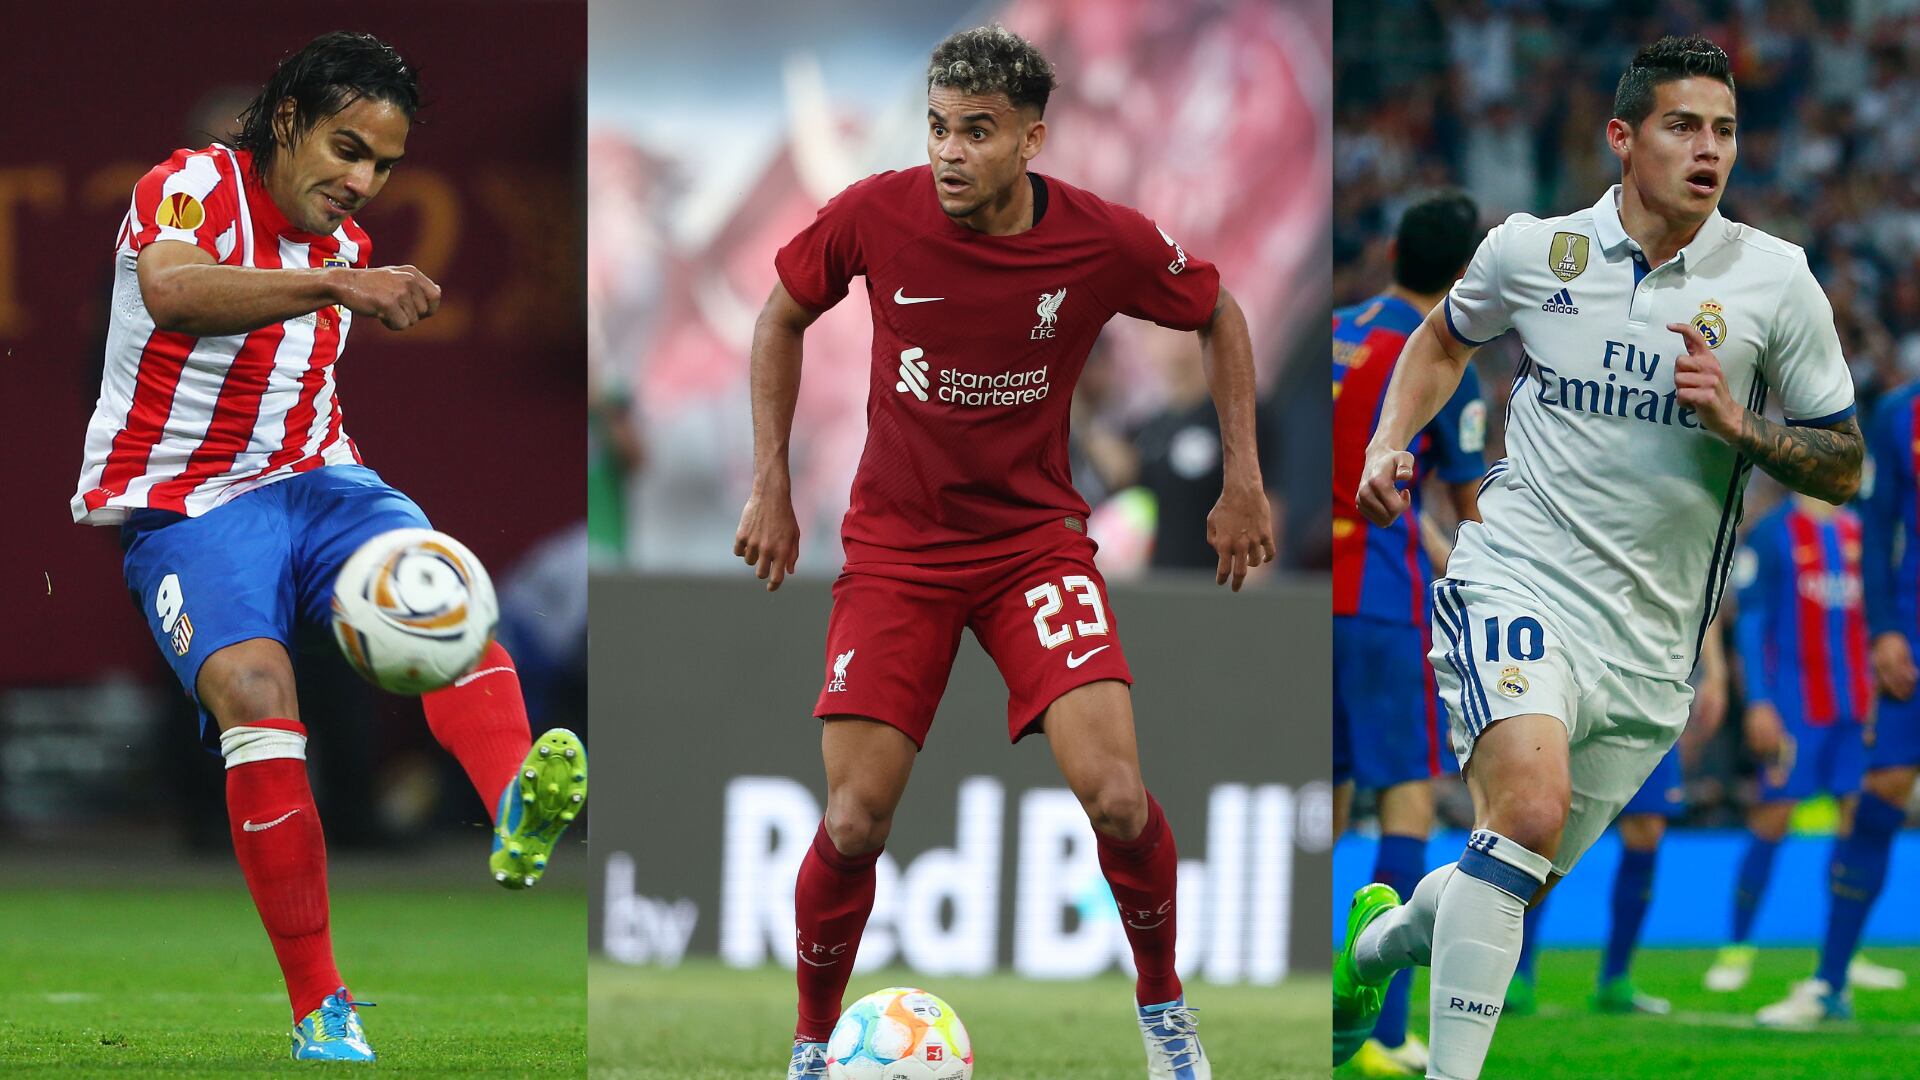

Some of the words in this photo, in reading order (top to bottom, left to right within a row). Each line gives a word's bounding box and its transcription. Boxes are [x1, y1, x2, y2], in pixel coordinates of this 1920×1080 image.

[1558, 262, 1577, 271] FIFA
[1541, 302, 1579, 315] adidas
[939, 365, 1048, 389] standard
[1602, 340, 1661, 382] Fly
[938, 381, 1050, 406] chartered
[1536, 363, 1709, 431] Emirate
[156, 573, 183, 633] 9
[1024, 575, 1109, 650] 23
[1484, 615, 1545, 662] 10
[603, 850, 699, 970] by
[1449, 996, 1501, 1017] RMCF
